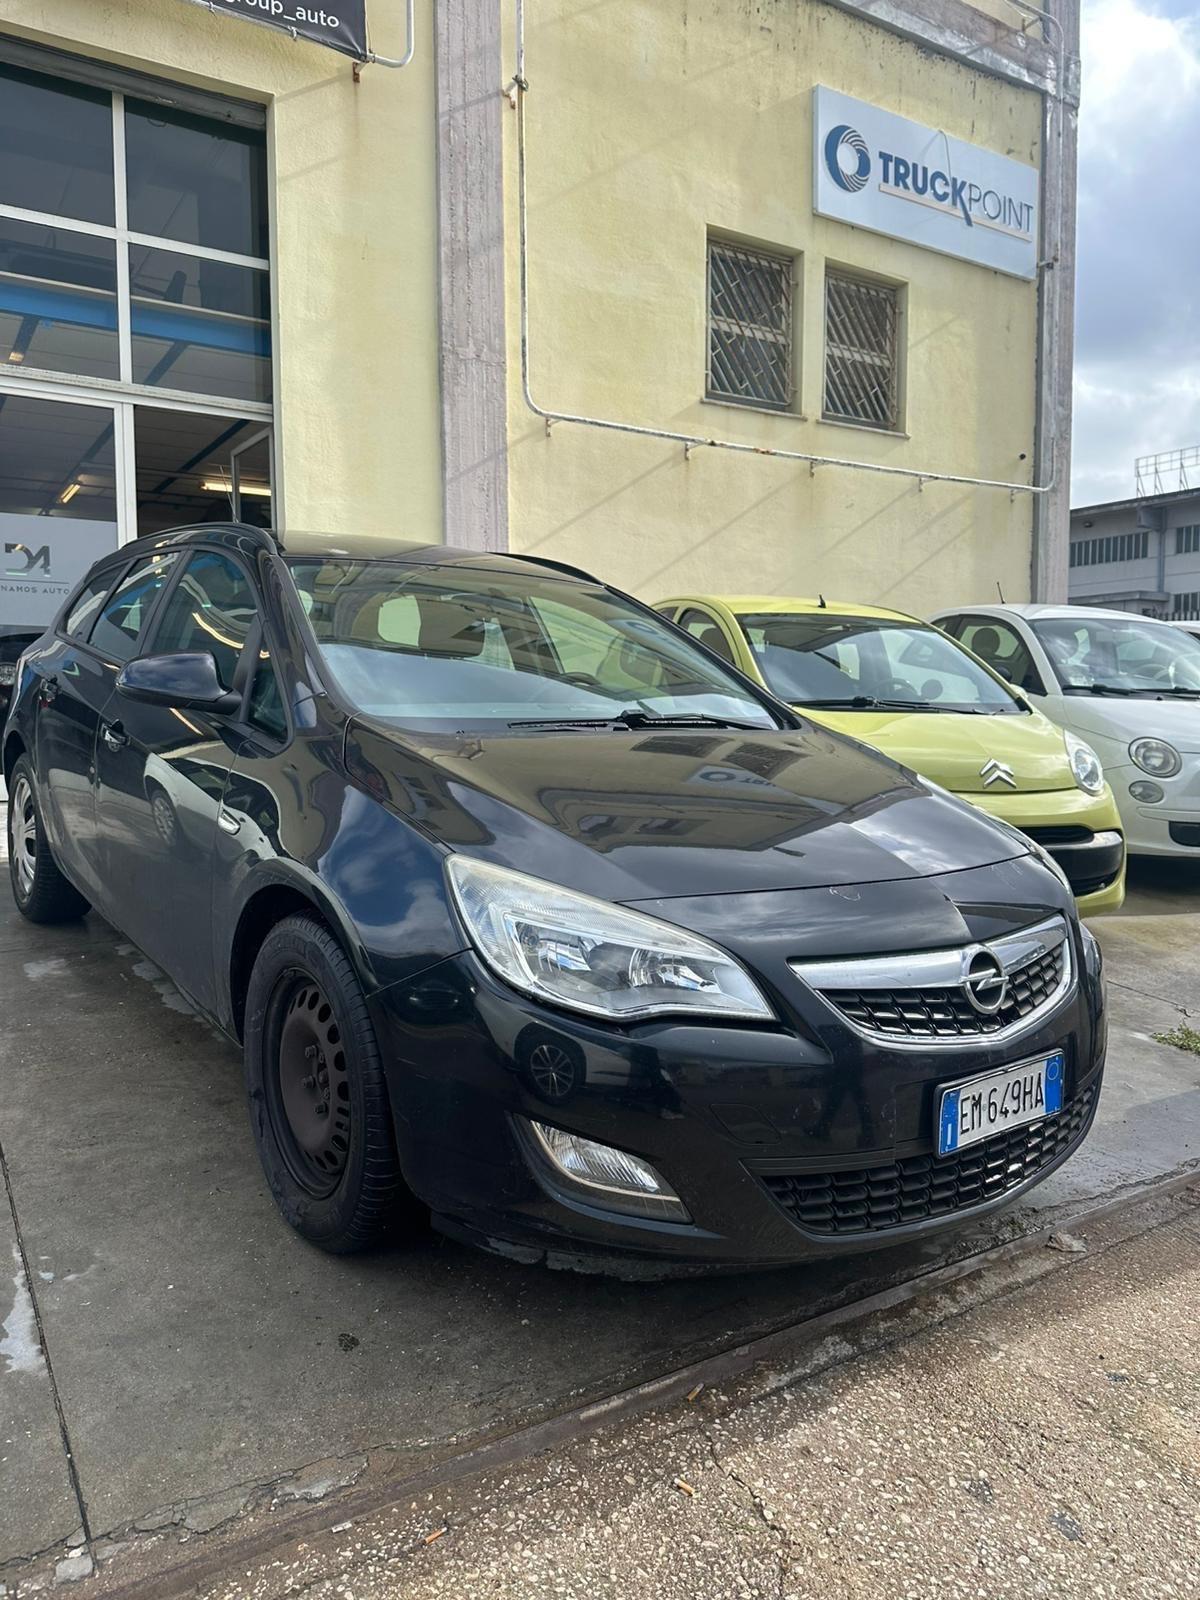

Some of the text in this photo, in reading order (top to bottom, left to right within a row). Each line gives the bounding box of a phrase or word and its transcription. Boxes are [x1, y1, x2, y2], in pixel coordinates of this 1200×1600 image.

[225, 0, 340, 28] oup_auto
[878, 150, 1034, 233] TRUCKPOINT
[42, 587, 70, 595] AUTO
